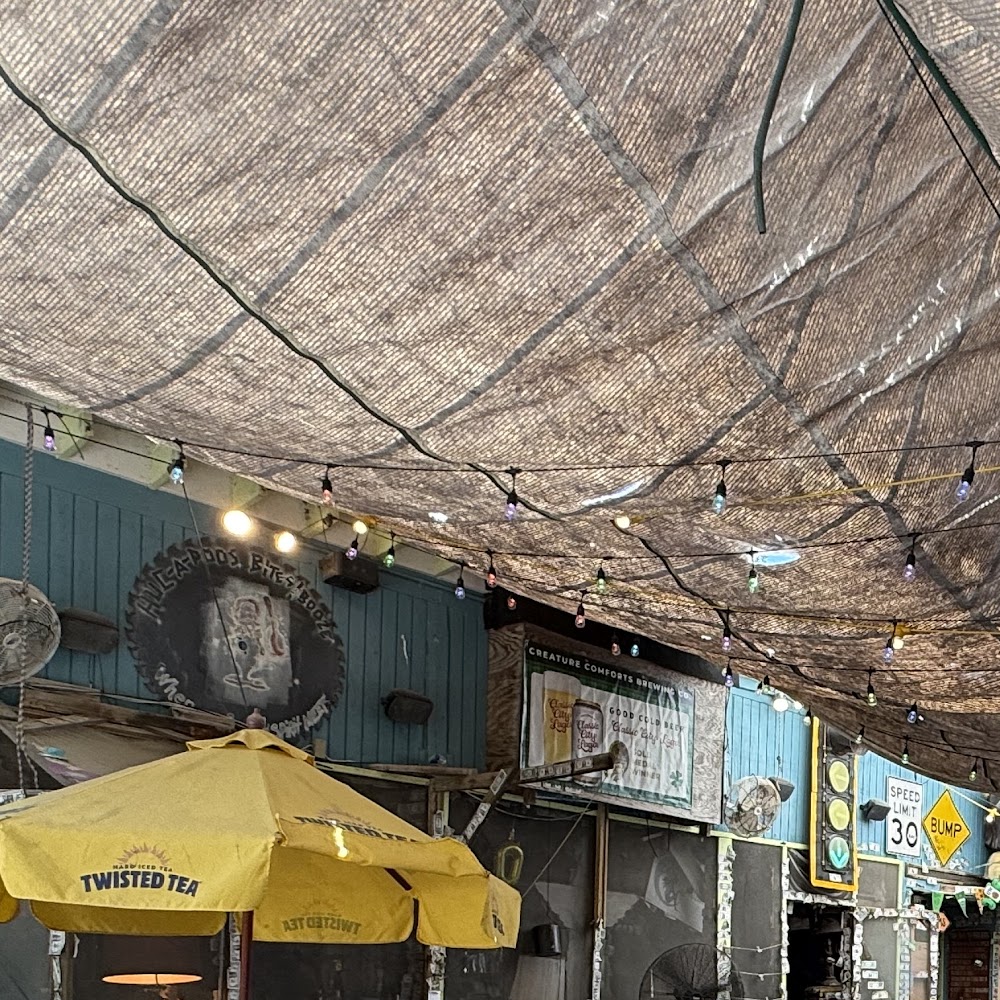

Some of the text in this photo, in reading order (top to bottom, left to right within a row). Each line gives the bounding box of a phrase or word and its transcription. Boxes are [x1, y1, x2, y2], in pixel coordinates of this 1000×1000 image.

[528, 646, 581, 669] CREATURE
[584, 662, 634, 684] COMFORTS
[636, 677, 675, 696] BREWING
[609, 706, 635, 720] GOOD
[638, 714, 661, 727] COLD
[890, 785, 920, 803] SPEED
[893, 802, 917, 818] LIMIT
[891, 818, 918, 848] 30
[930, 817, 962, 838] BUMP
[80, 870, 200, 897] TWISTED TEA
